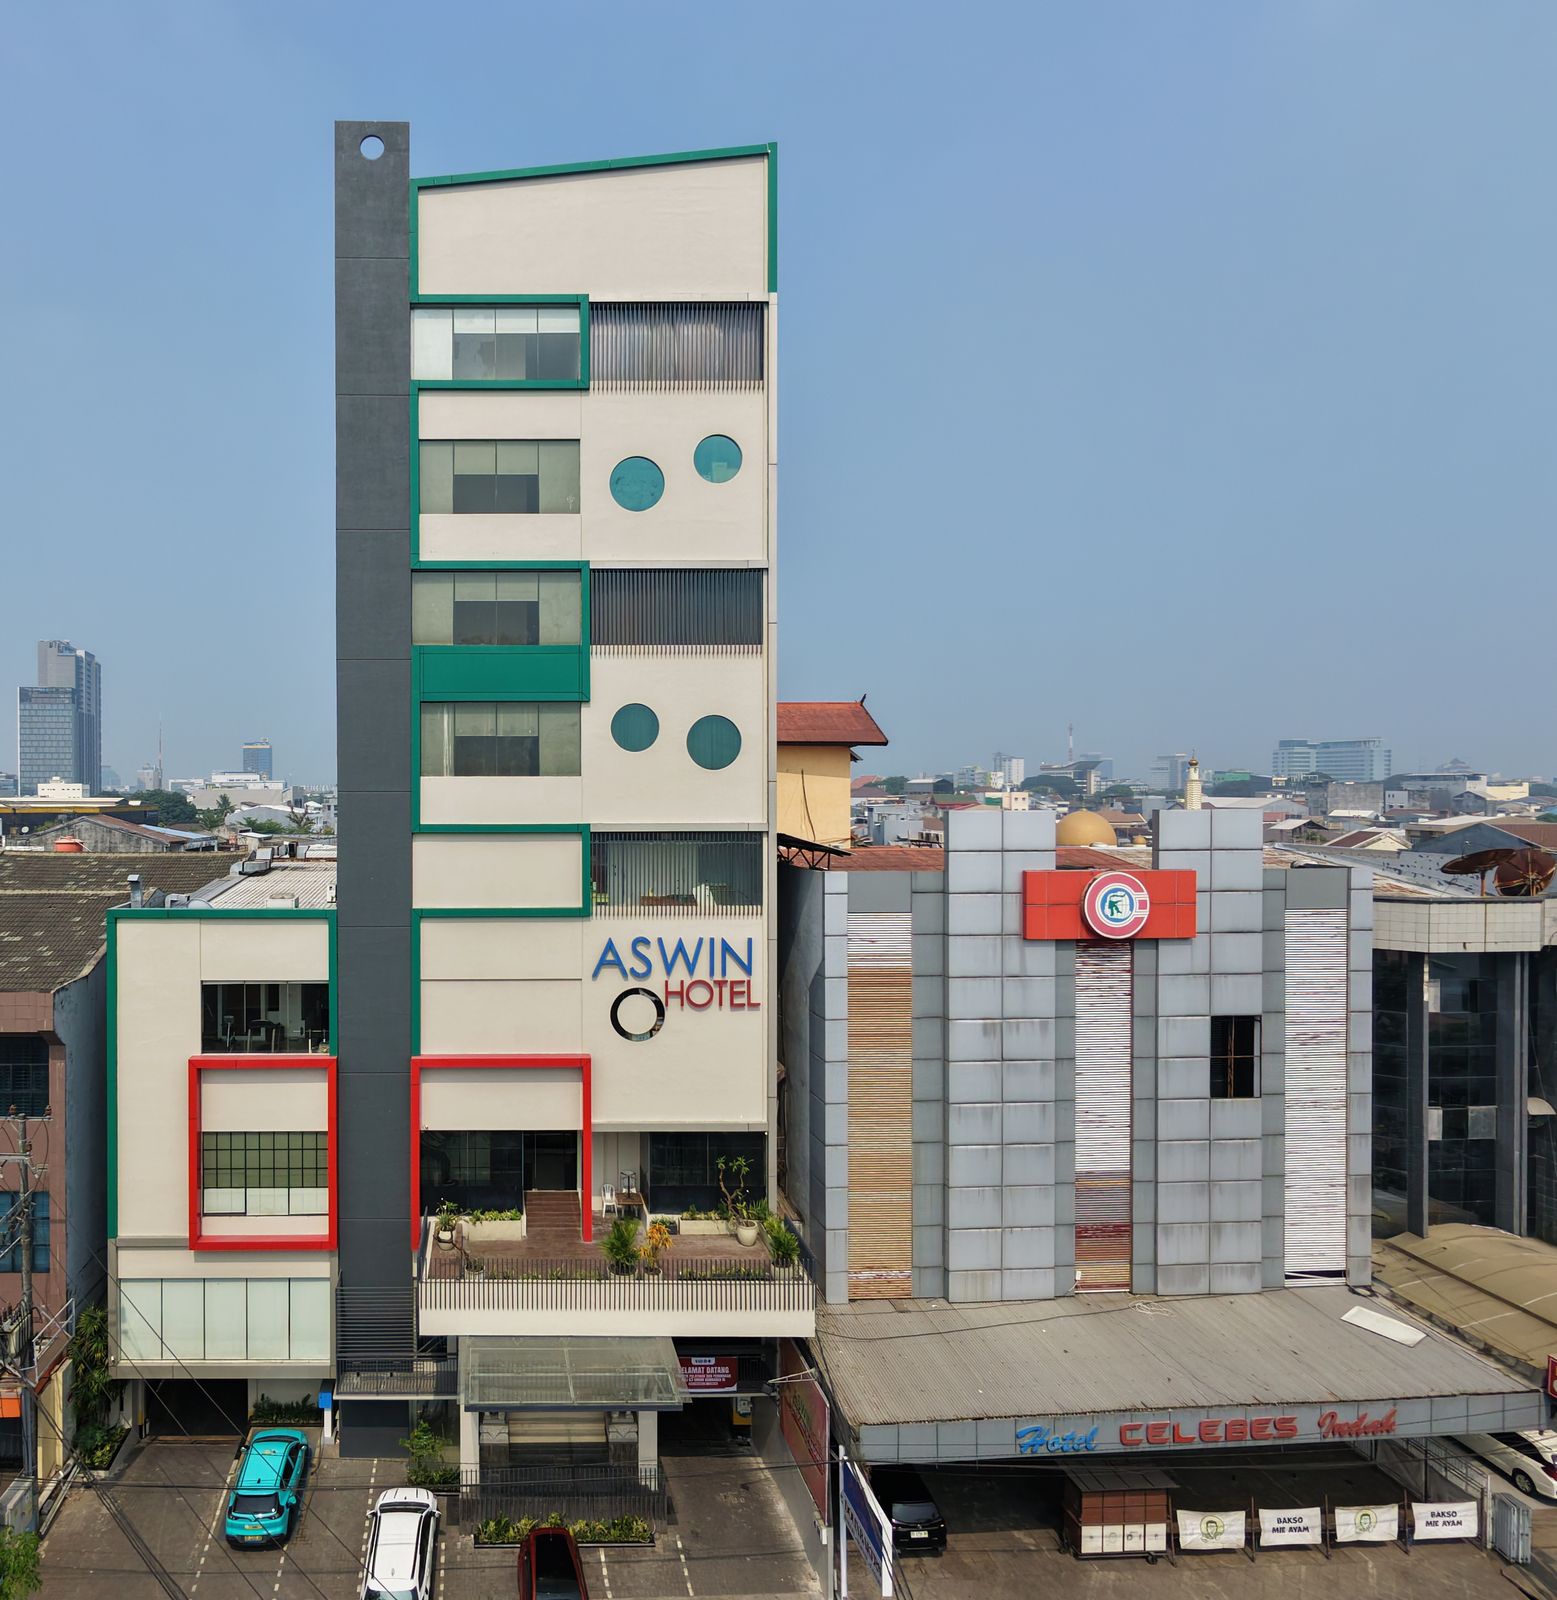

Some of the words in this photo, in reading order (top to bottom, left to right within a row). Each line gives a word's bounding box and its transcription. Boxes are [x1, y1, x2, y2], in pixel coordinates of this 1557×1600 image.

[592, 936, 753, 980] ASWIN
[664, 979, 761, 1009] HOTEL
[1016, 1425, 1099, 1454] Hotel
[1119, 1416, 1298, 1446] CELEBES
[1318, 1408, 1397, 1439] Indah
